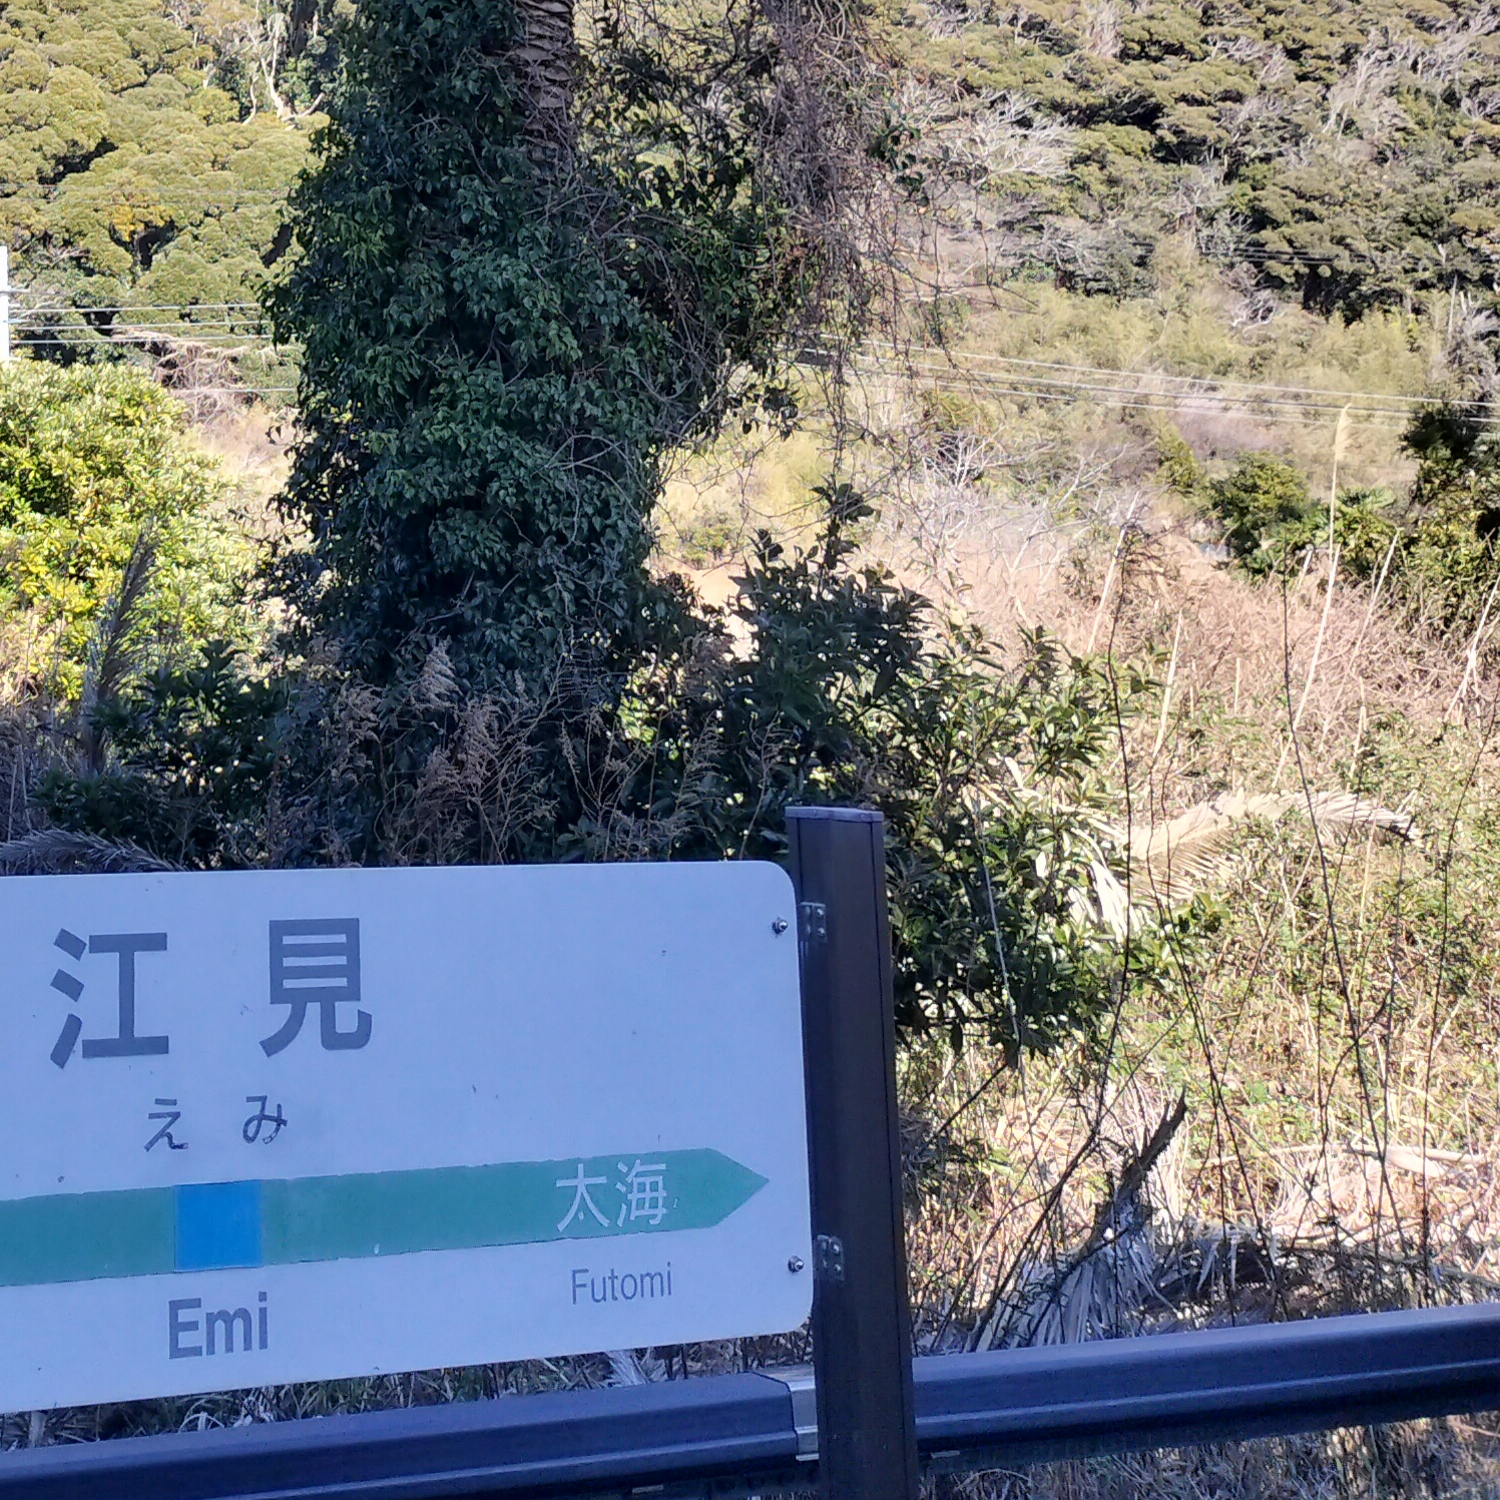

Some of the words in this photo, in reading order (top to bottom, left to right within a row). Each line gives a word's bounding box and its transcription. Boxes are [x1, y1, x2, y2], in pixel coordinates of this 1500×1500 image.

[51, 918, 373, 1069] 江見
[144, 1095, 287, 1151] えみ
[556, 1159, 667, 1232] 太海
[572, 1262, 672, 1304] Futomi
[168, 1292, 268, 1359] Emi
